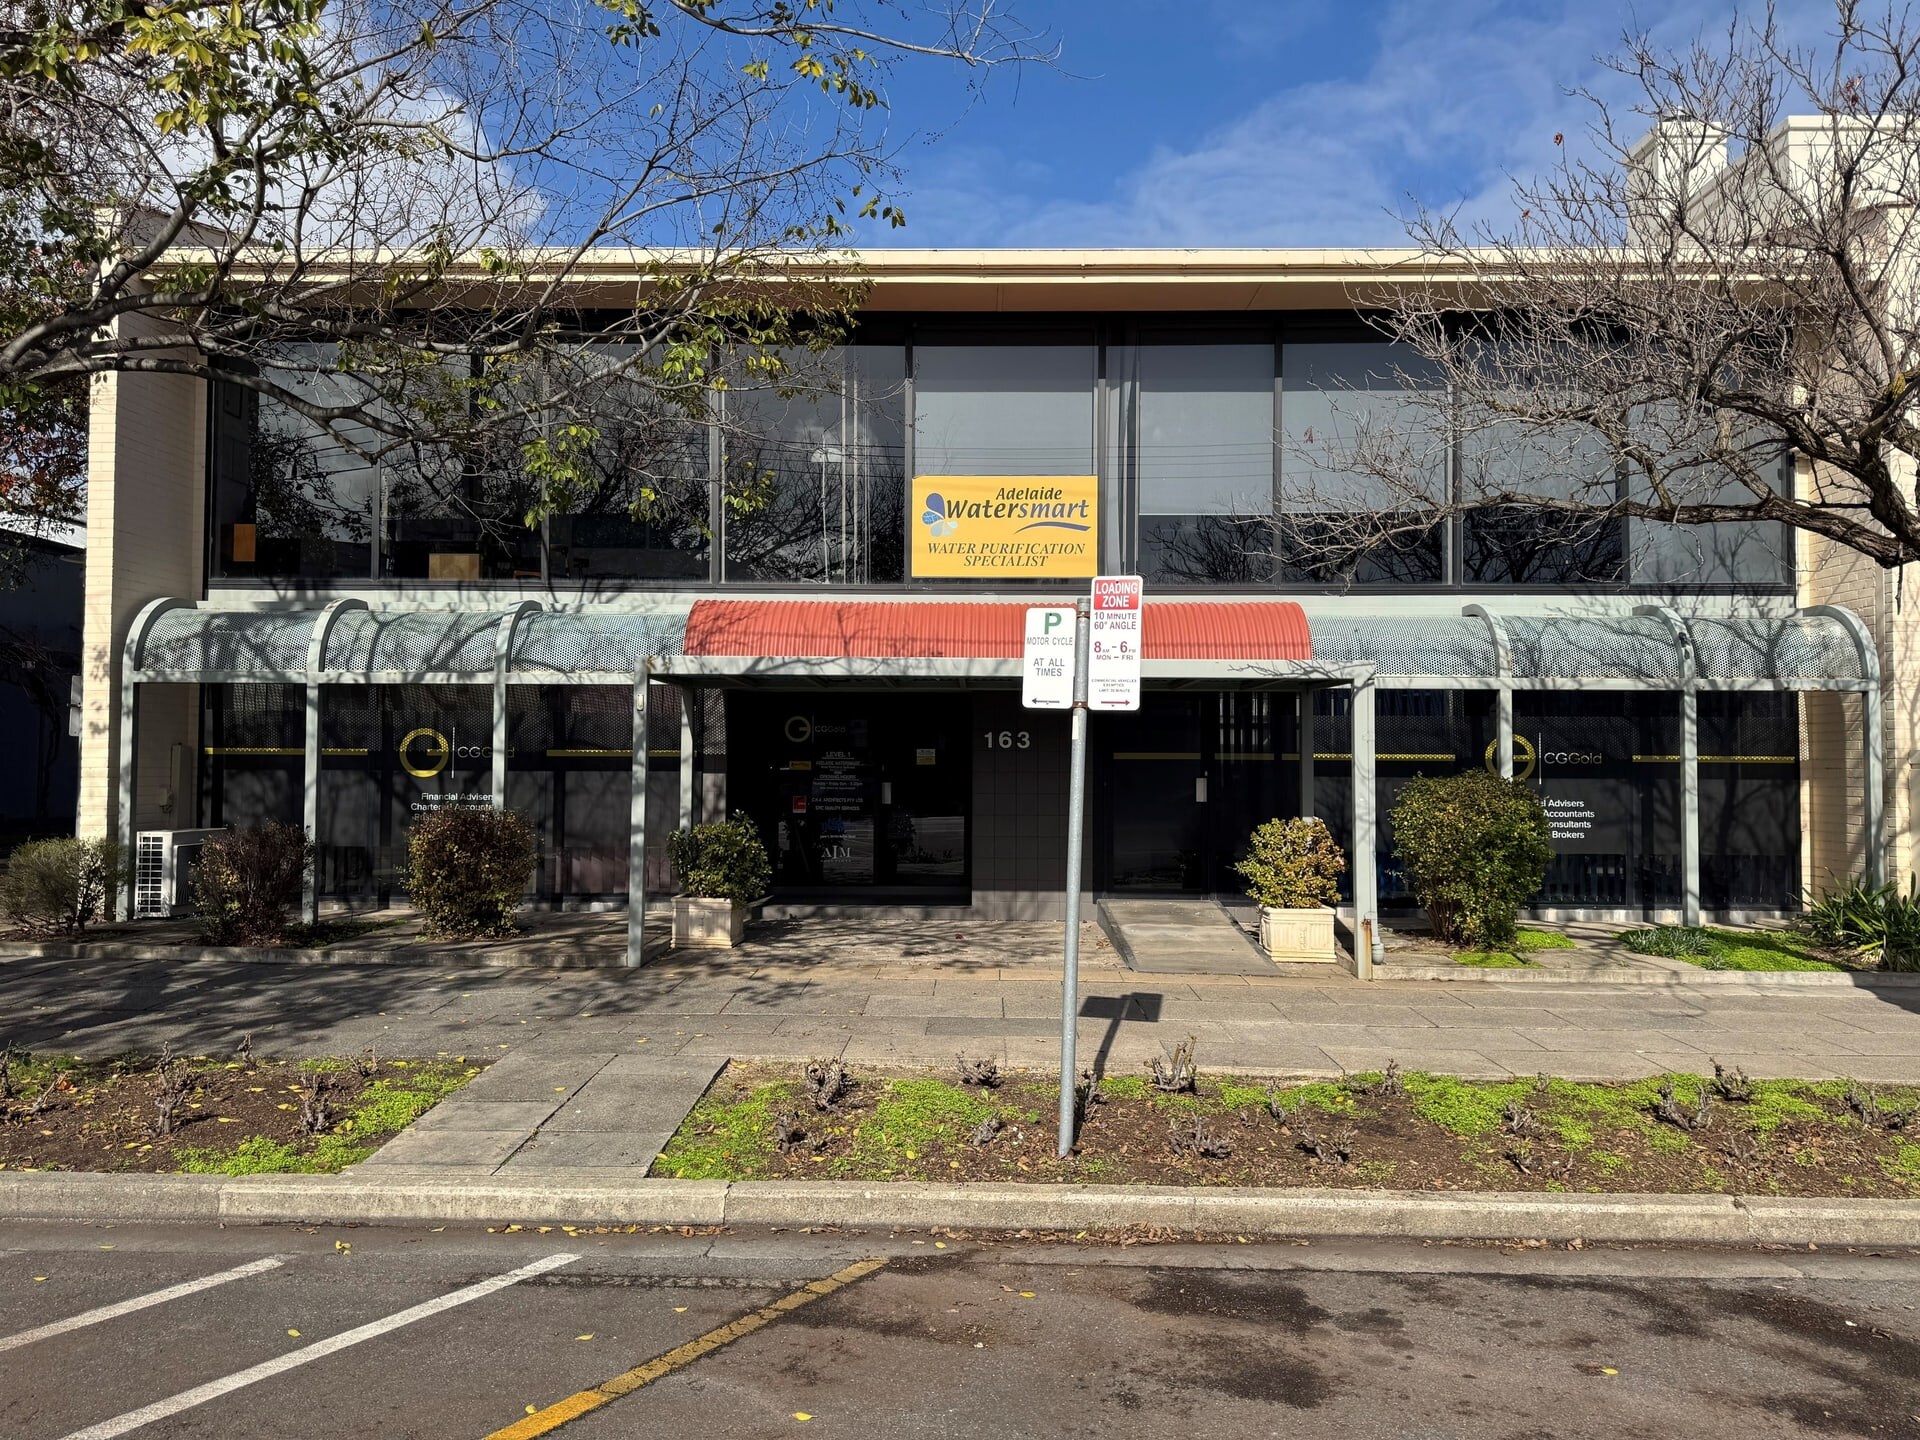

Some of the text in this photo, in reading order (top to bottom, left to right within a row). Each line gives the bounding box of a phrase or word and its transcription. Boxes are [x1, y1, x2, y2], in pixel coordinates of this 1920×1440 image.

[996, 486, 1063, 500] Adelaide
[947, 499, 1089, 519] Watersmart
[928, 543, 1086, 554] WATER PURIFICATION
[963, 556, 1048, 567] SPECIALIST
[1096, 582, 1138, 594] LOADING
[1102, 595, 1130, 608] ZONE
[1094, 611, 1137, 620] 10 MINUTE
[1044, 612, 1062, 635] P
[1109, 621, 1137, 630] ANGLE
[1026, 637, 1073, 646] MOTOR CYCLE
[1033, 658, 1065, 667] AT ALL
[1036, 668, 1062, 677] TIMES
[984, 731, 1031, 749] 163
[1544, 752, 1602, 765] CGGold
[421, 792, 458, 801] Financial
[1548, 799, 1585, 808] Advisers
[1543, 810, 1595, 818] Accountants
[1548, 820, 1592, 829] onsultants
[1552, 830, 1585, 839] Brokers
